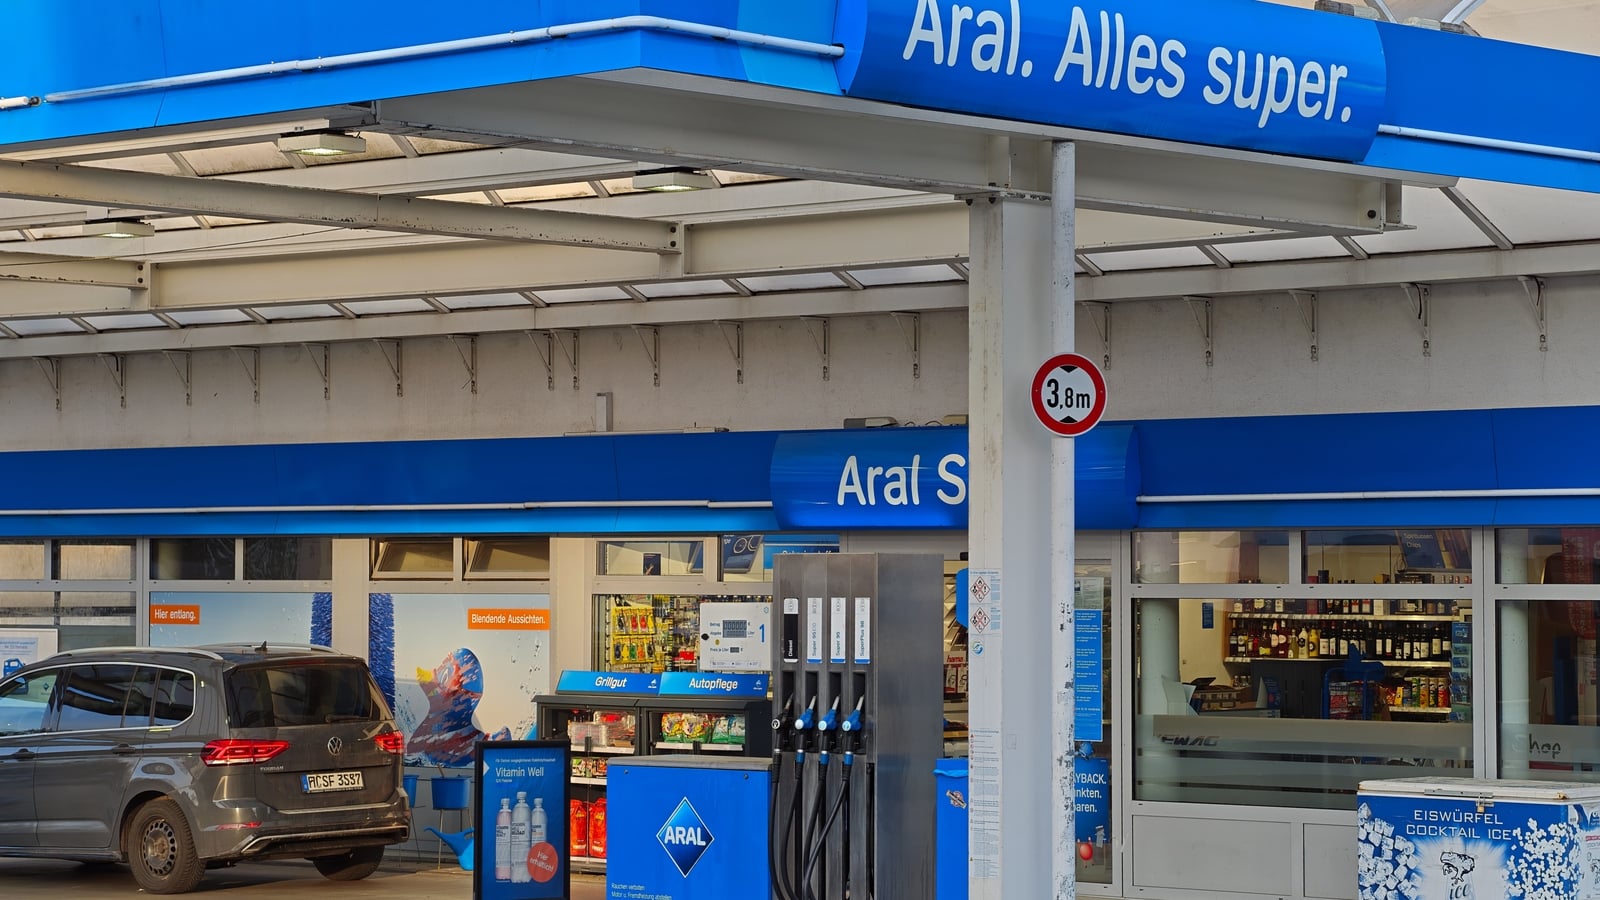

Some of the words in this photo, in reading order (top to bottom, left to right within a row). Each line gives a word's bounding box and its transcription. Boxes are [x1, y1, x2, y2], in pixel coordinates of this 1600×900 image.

[902, 0, 1033, 78] Aral.
[1054, 6, 1185, 98] Alles
[1202, 46, 1351, 128] super.
[837, 454, 920, 506] Aral
[154, 609, 168, 620] Hier
[169, 609, 196, 621] entlang.
[471, 613, 505, 625] Blendende
[507, 613, 545, 625] Aussichten.
[759, 623, 765, 643] 1
[595, 676, 627, 689] Grillgut
[689, 678, 738, 691] Autopflege
[496, 766, 525, 777] Vitamin
[527, 766, 545, 777] Well
[1414, 808, 1503, 825] EISWÜRFEL
[664, 825, 706, 847] ARAL
[1406, 825, 1480, 839] COCKTAIL
[1488, 829, 1512, 840] ICE
[537, 851, 548, 861] Hier
